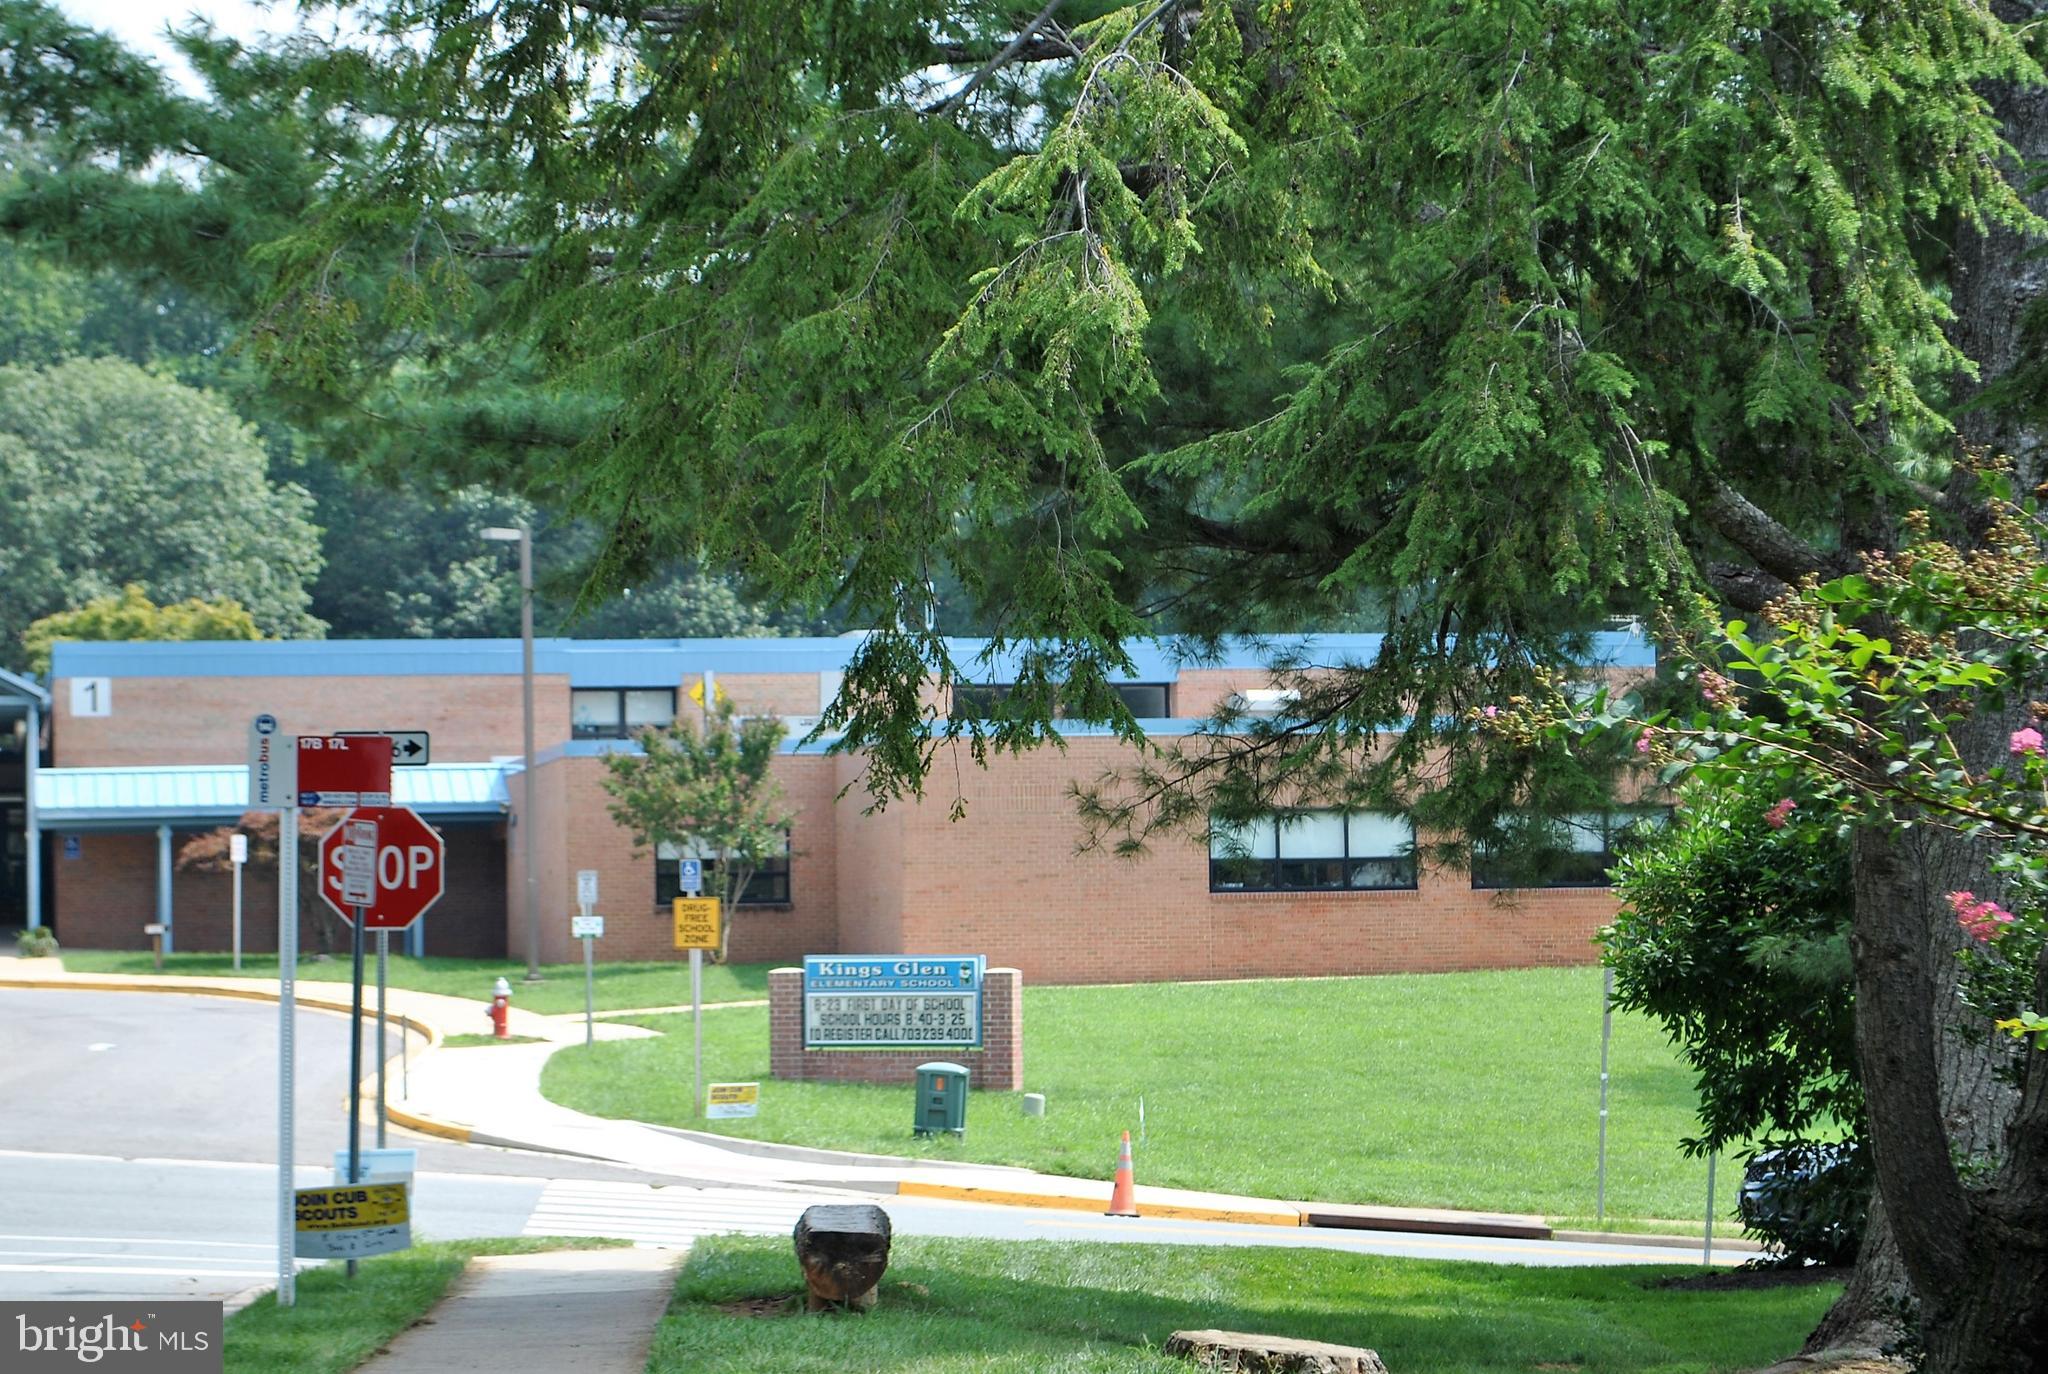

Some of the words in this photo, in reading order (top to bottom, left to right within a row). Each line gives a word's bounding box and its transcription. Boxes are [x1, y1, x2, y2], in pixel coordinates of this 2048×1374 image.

[84, 681, 98, 712] 1
[327, 738, 349, 750] 17L
[257, 738, 270, 803] metrobus
[328, 845, 435, 890] SOP
[684, 914, 709, 922] FREE
[678, 924, 715, 933] SCHOOL
[684, 934, 709, 943] ZONE
[818, 961, 882, 978] Kings
[894, 961, 946, 976] Glen
[810, 979, 896, 988] ELEMENTARY
[901, 978, 955, 987] SCHOOL
[847, 998, 876, 1011] FIRST
[882, 998, 900, 1011] DAY
[906, 998, 919, 1010] OF
[924, 998, 966, 1010] SCHOOL
[820, 1013, 861, 1026] SCHOOL
[865, 1013, 900, 1026] HOURS
[824, 1028, 872, 1041] REGISTER
[875, 1028, 900, 1041] CALL
[333, 1190, 368, 1204] CUB
